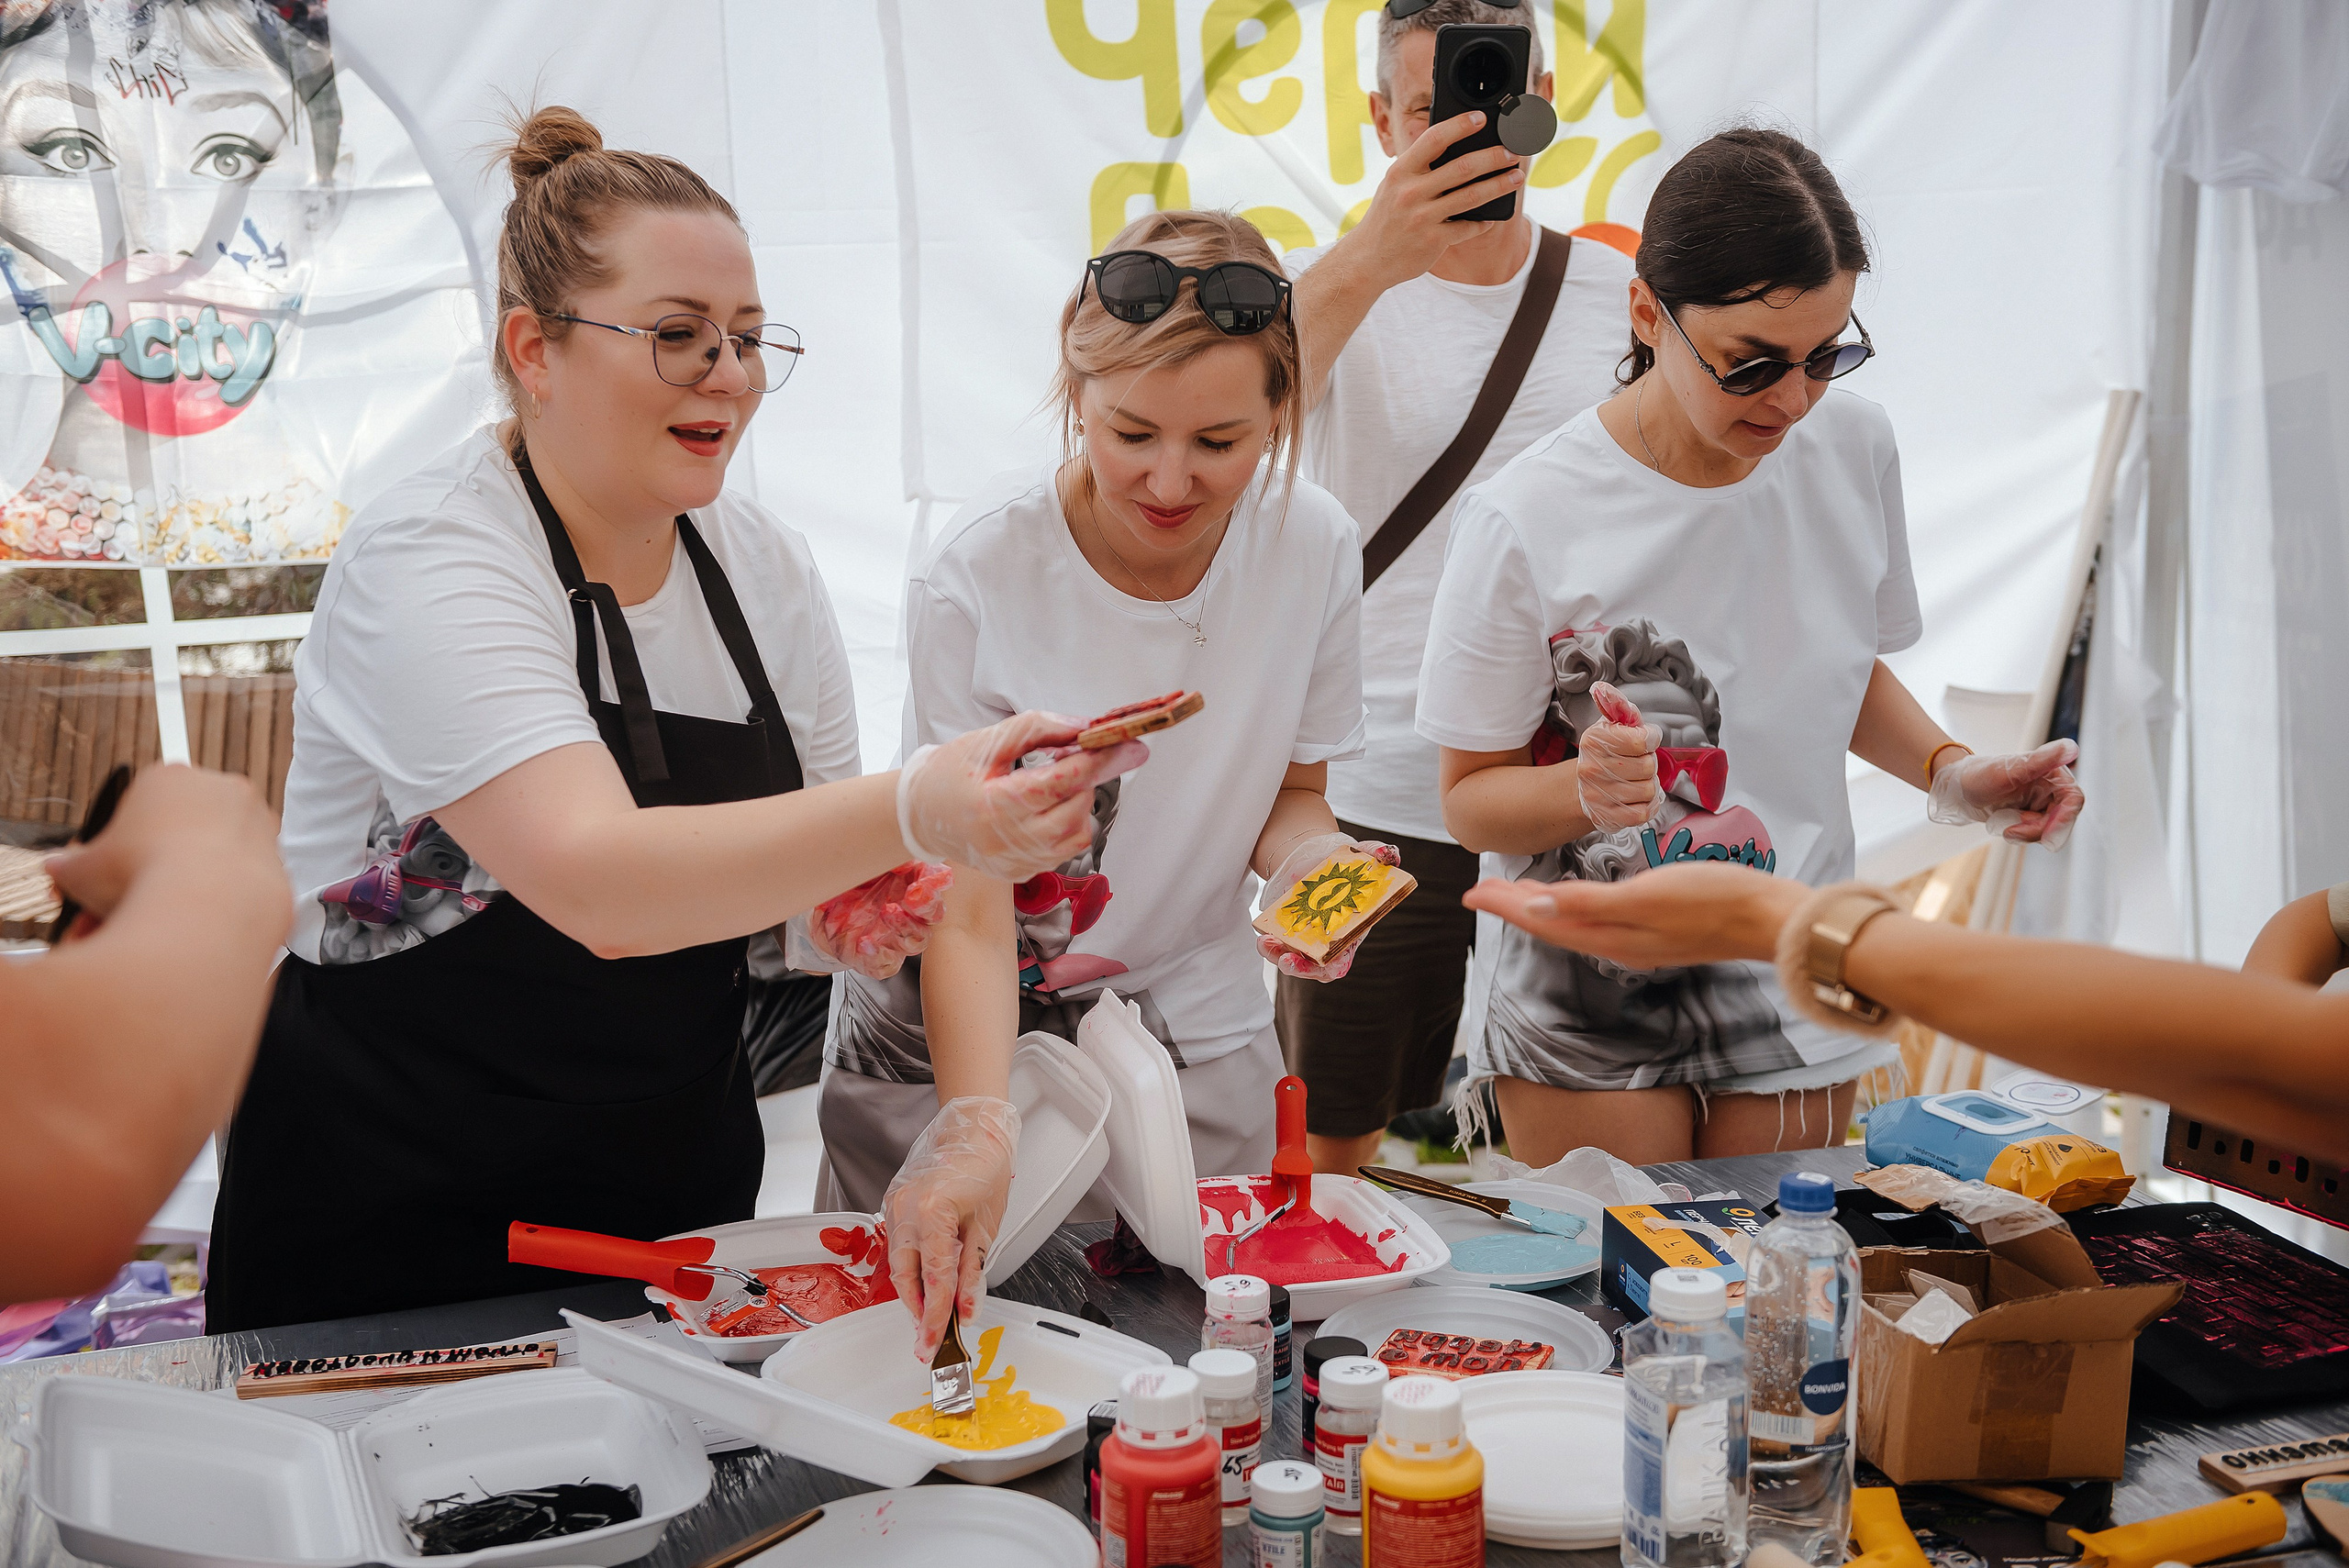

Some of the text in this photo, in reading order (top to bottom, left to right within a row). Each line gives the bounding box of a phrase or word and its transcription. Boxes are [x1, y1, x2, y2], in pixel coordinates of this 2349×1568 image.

[28, 301, 276, 407] V-city
[1684, 1254, 1703, 1266] 100
[1803, 1382, 1847, 1395] BONVIDA
[1222, 1454, 1248, 1475] 65
